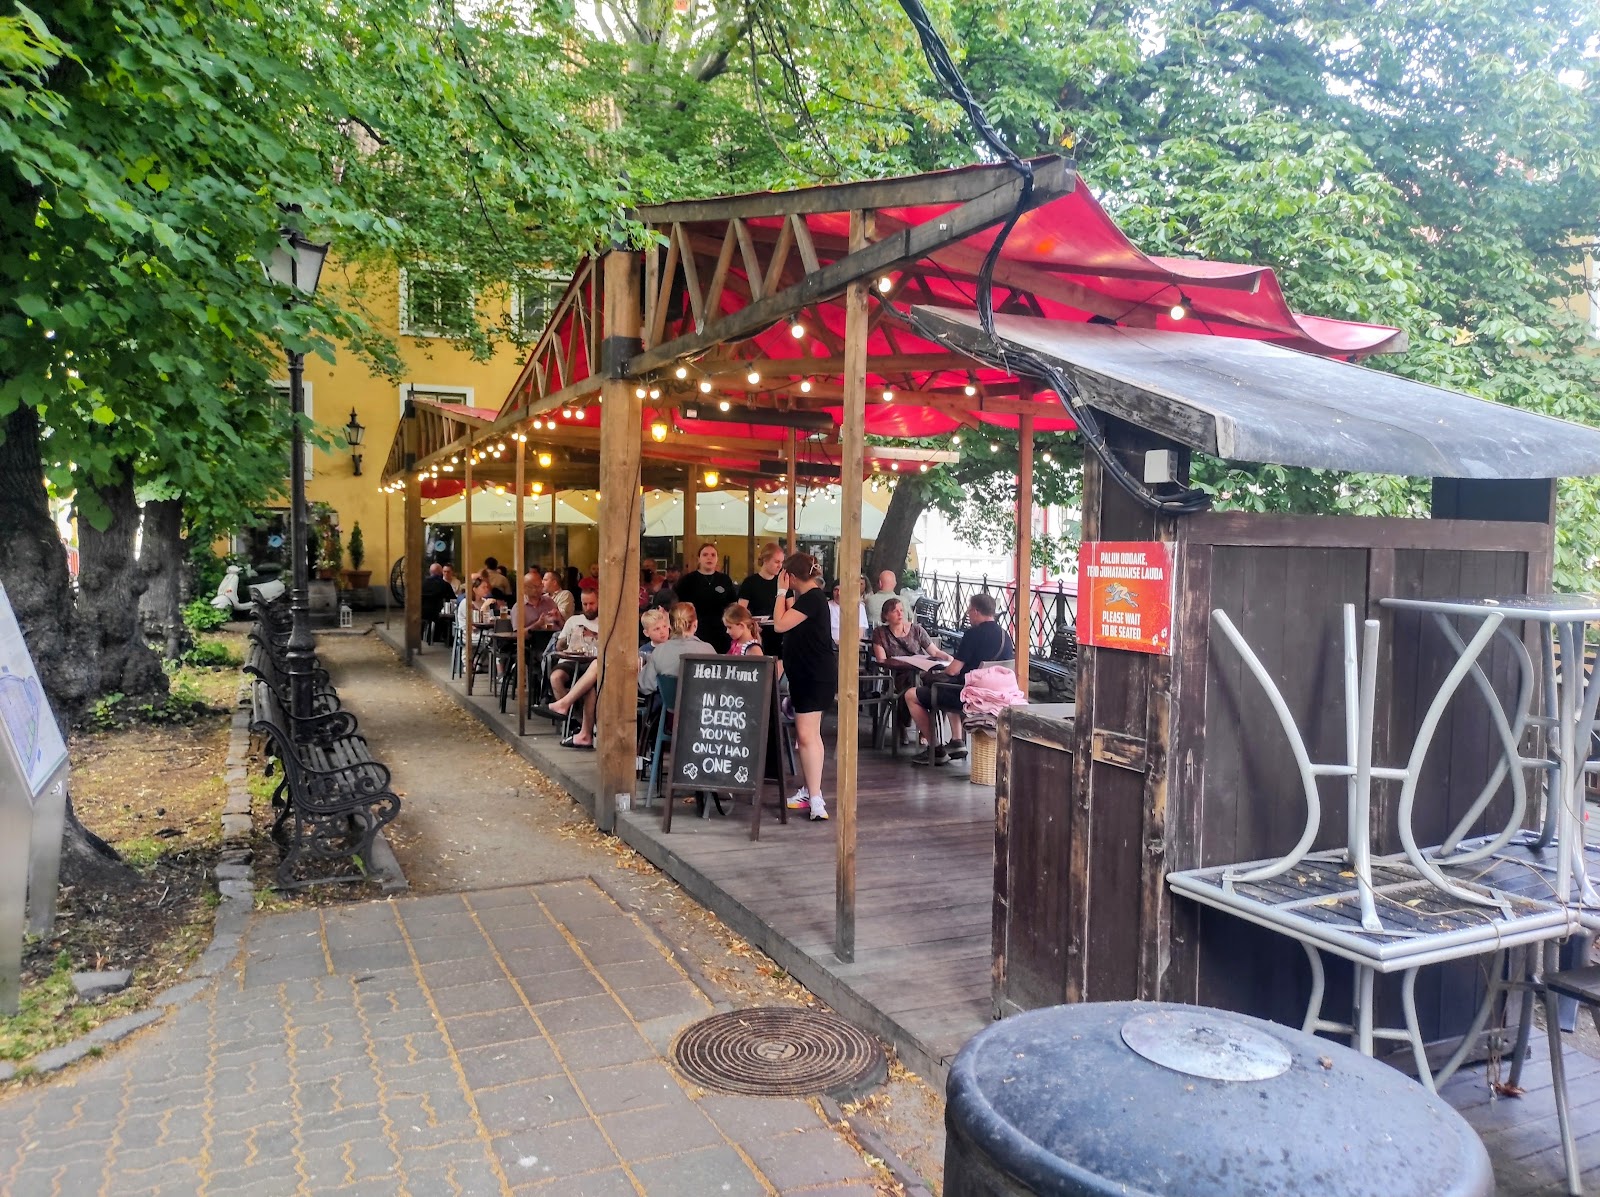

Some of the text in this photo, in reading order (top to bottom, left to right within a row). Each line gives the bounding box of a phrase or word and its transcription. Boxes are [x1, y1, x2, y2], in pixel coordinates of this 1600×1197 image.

[1100, 552, 1120, 565] PALUN
[1141, 567, 1164, 580] LAUDA
[1102, 610, 1141, 625] PLEASE WAIT
[1102, 624, 1141, 640] TO BE SEATED
[693, 663, 759, 682] Hell Hunt
[702, 693, 744, 708] IN DOG
[700, 708, 746, 729] BEERS
[700, 727, 741, 743] YOU'VE
[692, 742, 749, 758] ONLY HAD
[702, 757, 732, 773] ONE
